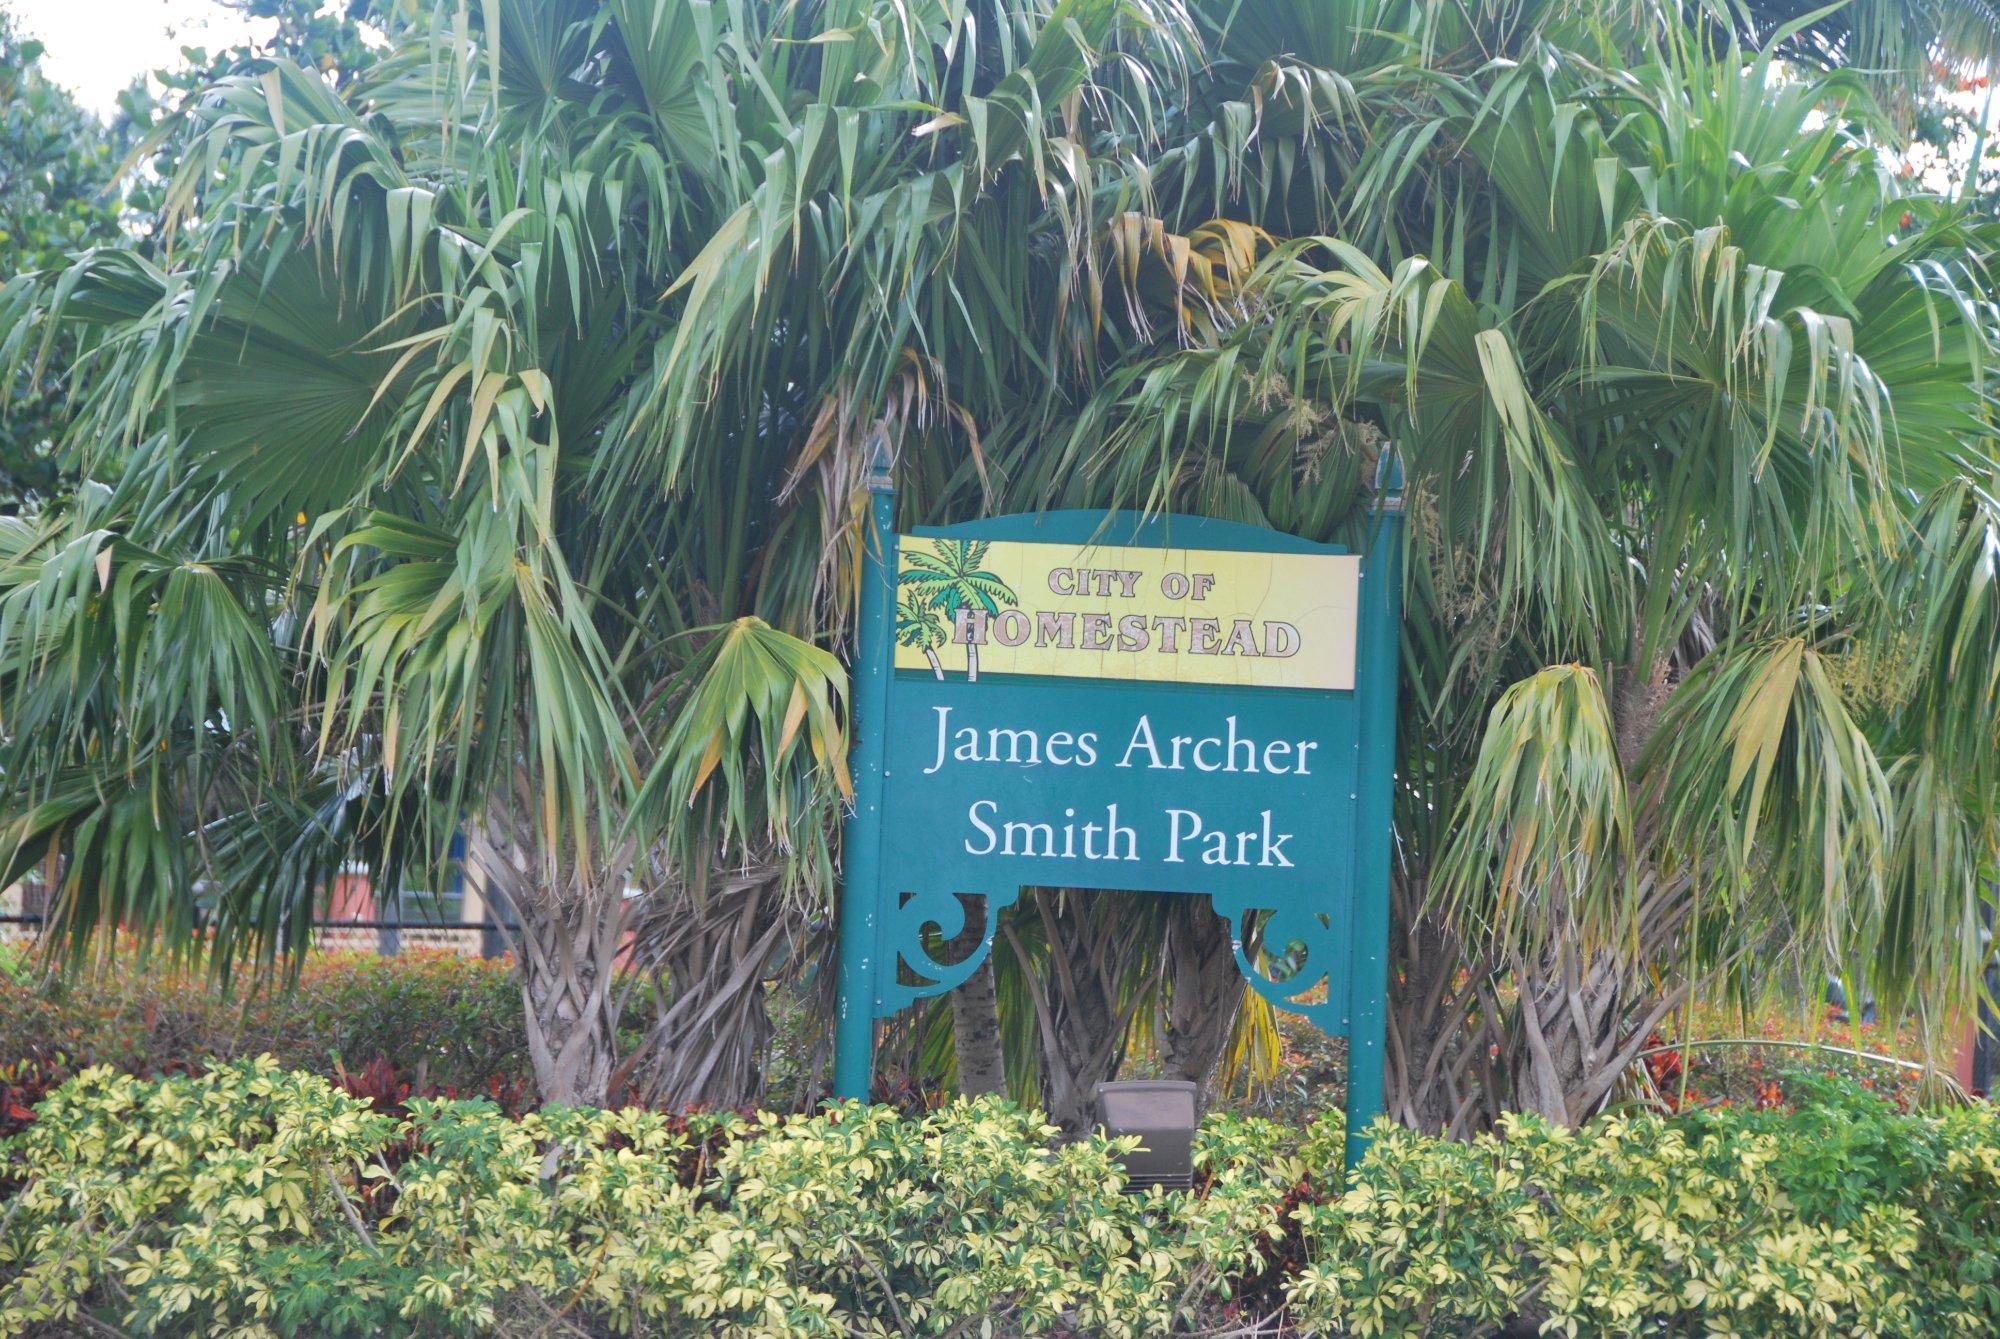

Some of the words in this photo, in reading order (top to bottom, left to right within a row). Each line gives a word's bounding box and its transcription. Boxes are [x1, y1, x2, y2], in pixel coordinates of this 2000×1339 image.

[1047, 567, 1143, 598] CITY
[1160, 571, 1216, 601] OF
[952, 607, 1302, 659] HOMESTEAD
[923, 705, 1099, 775] James
[1115, 714, 1319, 776] Archer
[964, 800, 1140, 862] Smith
[1163, 808, 1295, 868] Park
